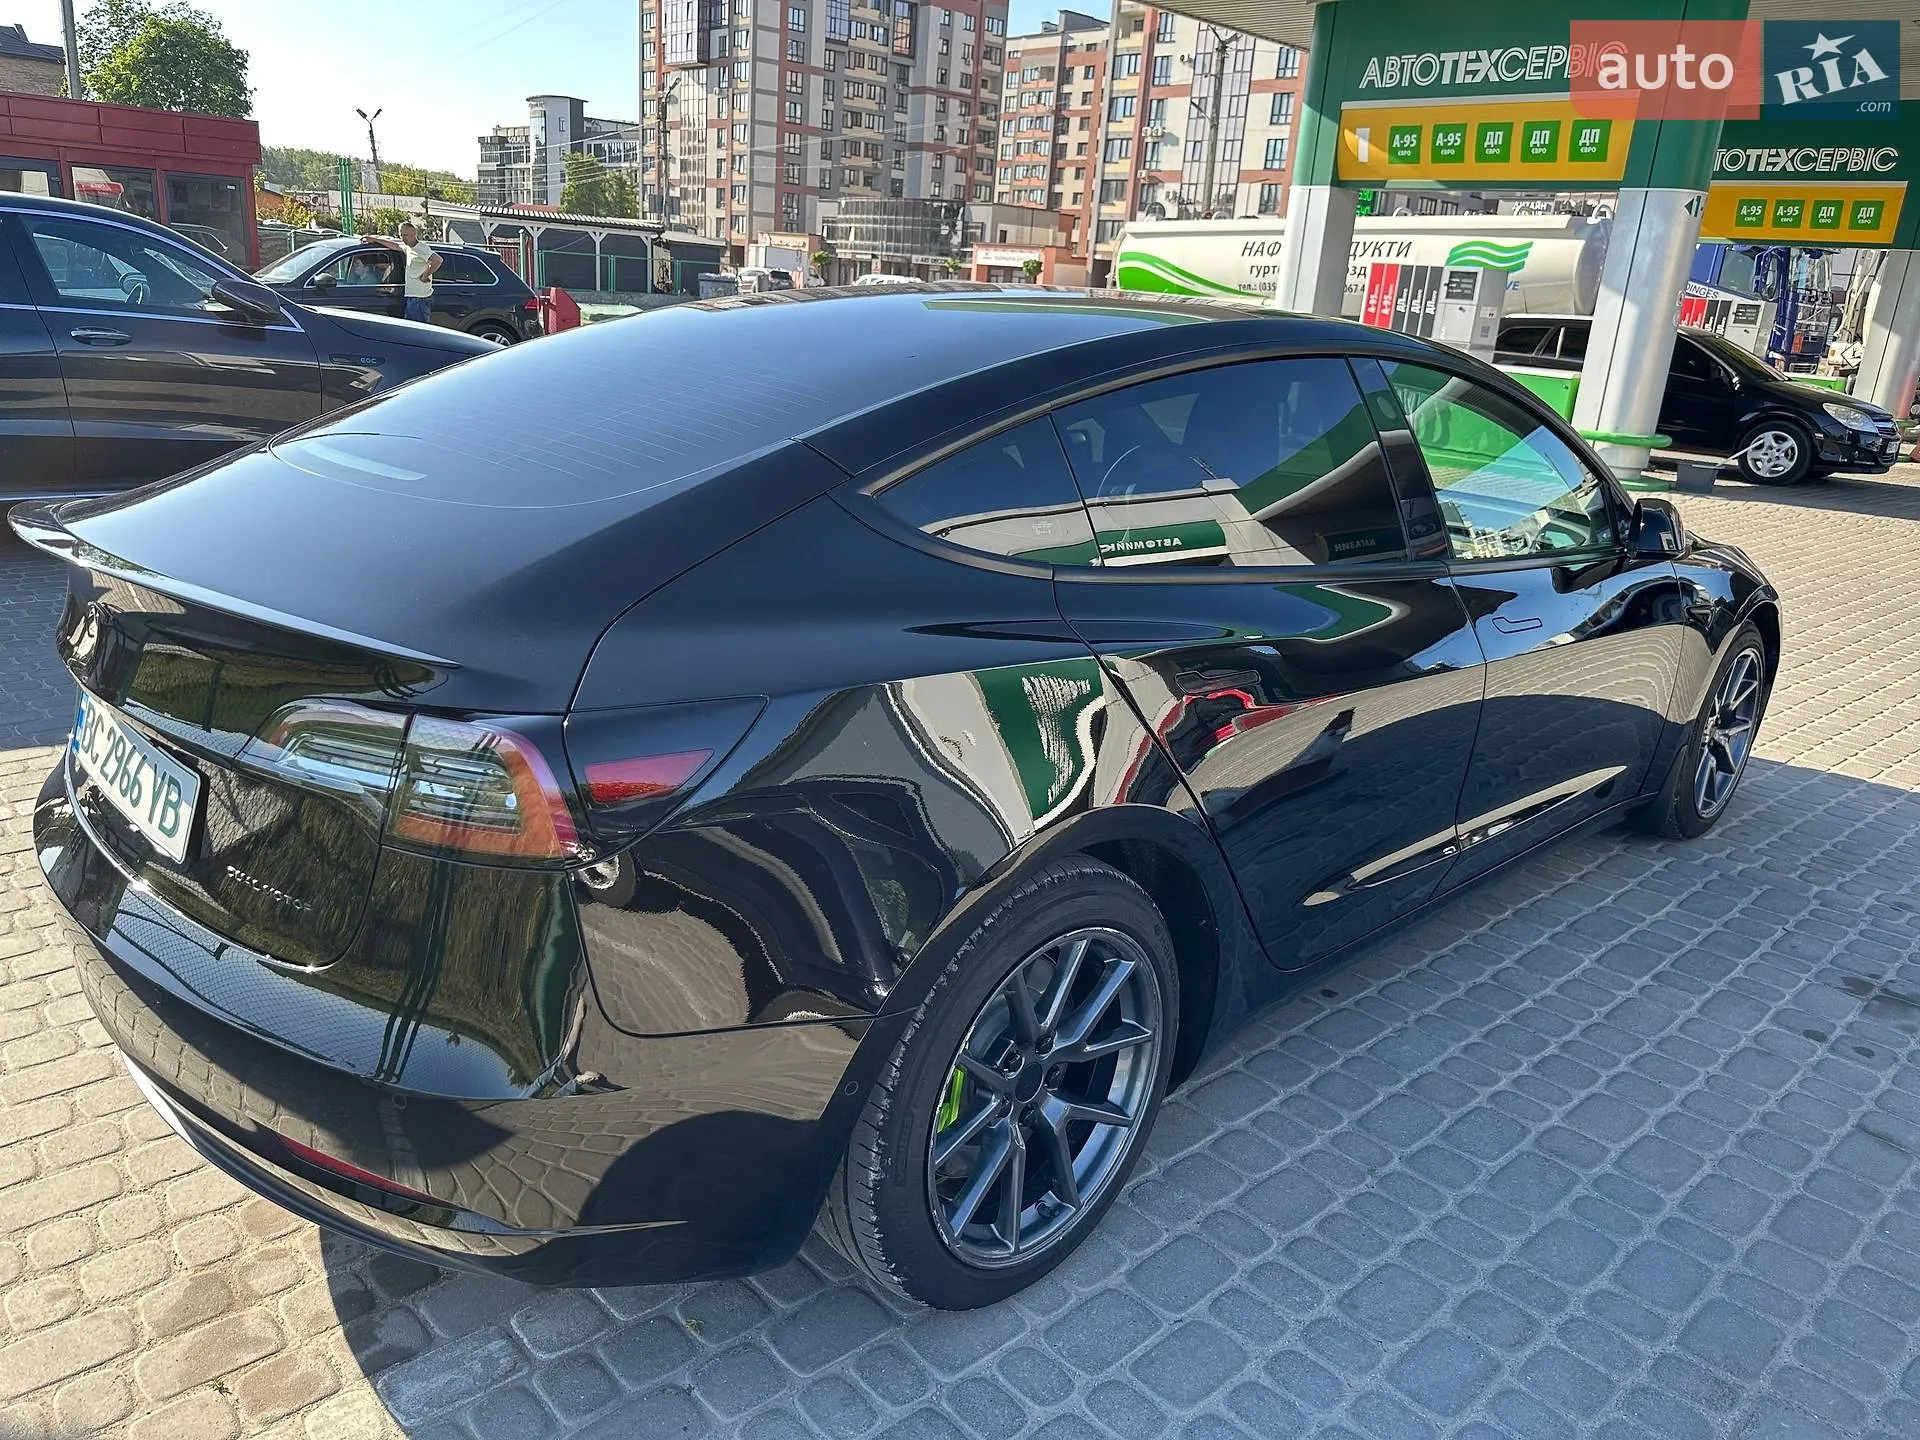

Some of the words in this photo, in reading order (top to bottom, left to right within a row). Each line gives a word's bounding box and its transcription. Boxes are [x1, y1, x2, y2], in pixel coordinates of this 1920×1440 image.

[1359, 41, 1629, 88] АВТОТЕХСЕРВІС
[1356, 128, 1370, 163] 1
[1484, 130, 1504, 148] ДП
[1529, 130, 1550, 146] ДП
[1579, 128, 1600, 146] ДП
[1713, 147, 1899, 172] ТОТЕХСЕРВІС
[1818, 206, 1835, 217] ДП
[1857, 207, 1875, 219] ДП
[81, 701, 104, 765] BC
[99, 726, 148, 808] 2966
[147, 761, 182, 839] YB
